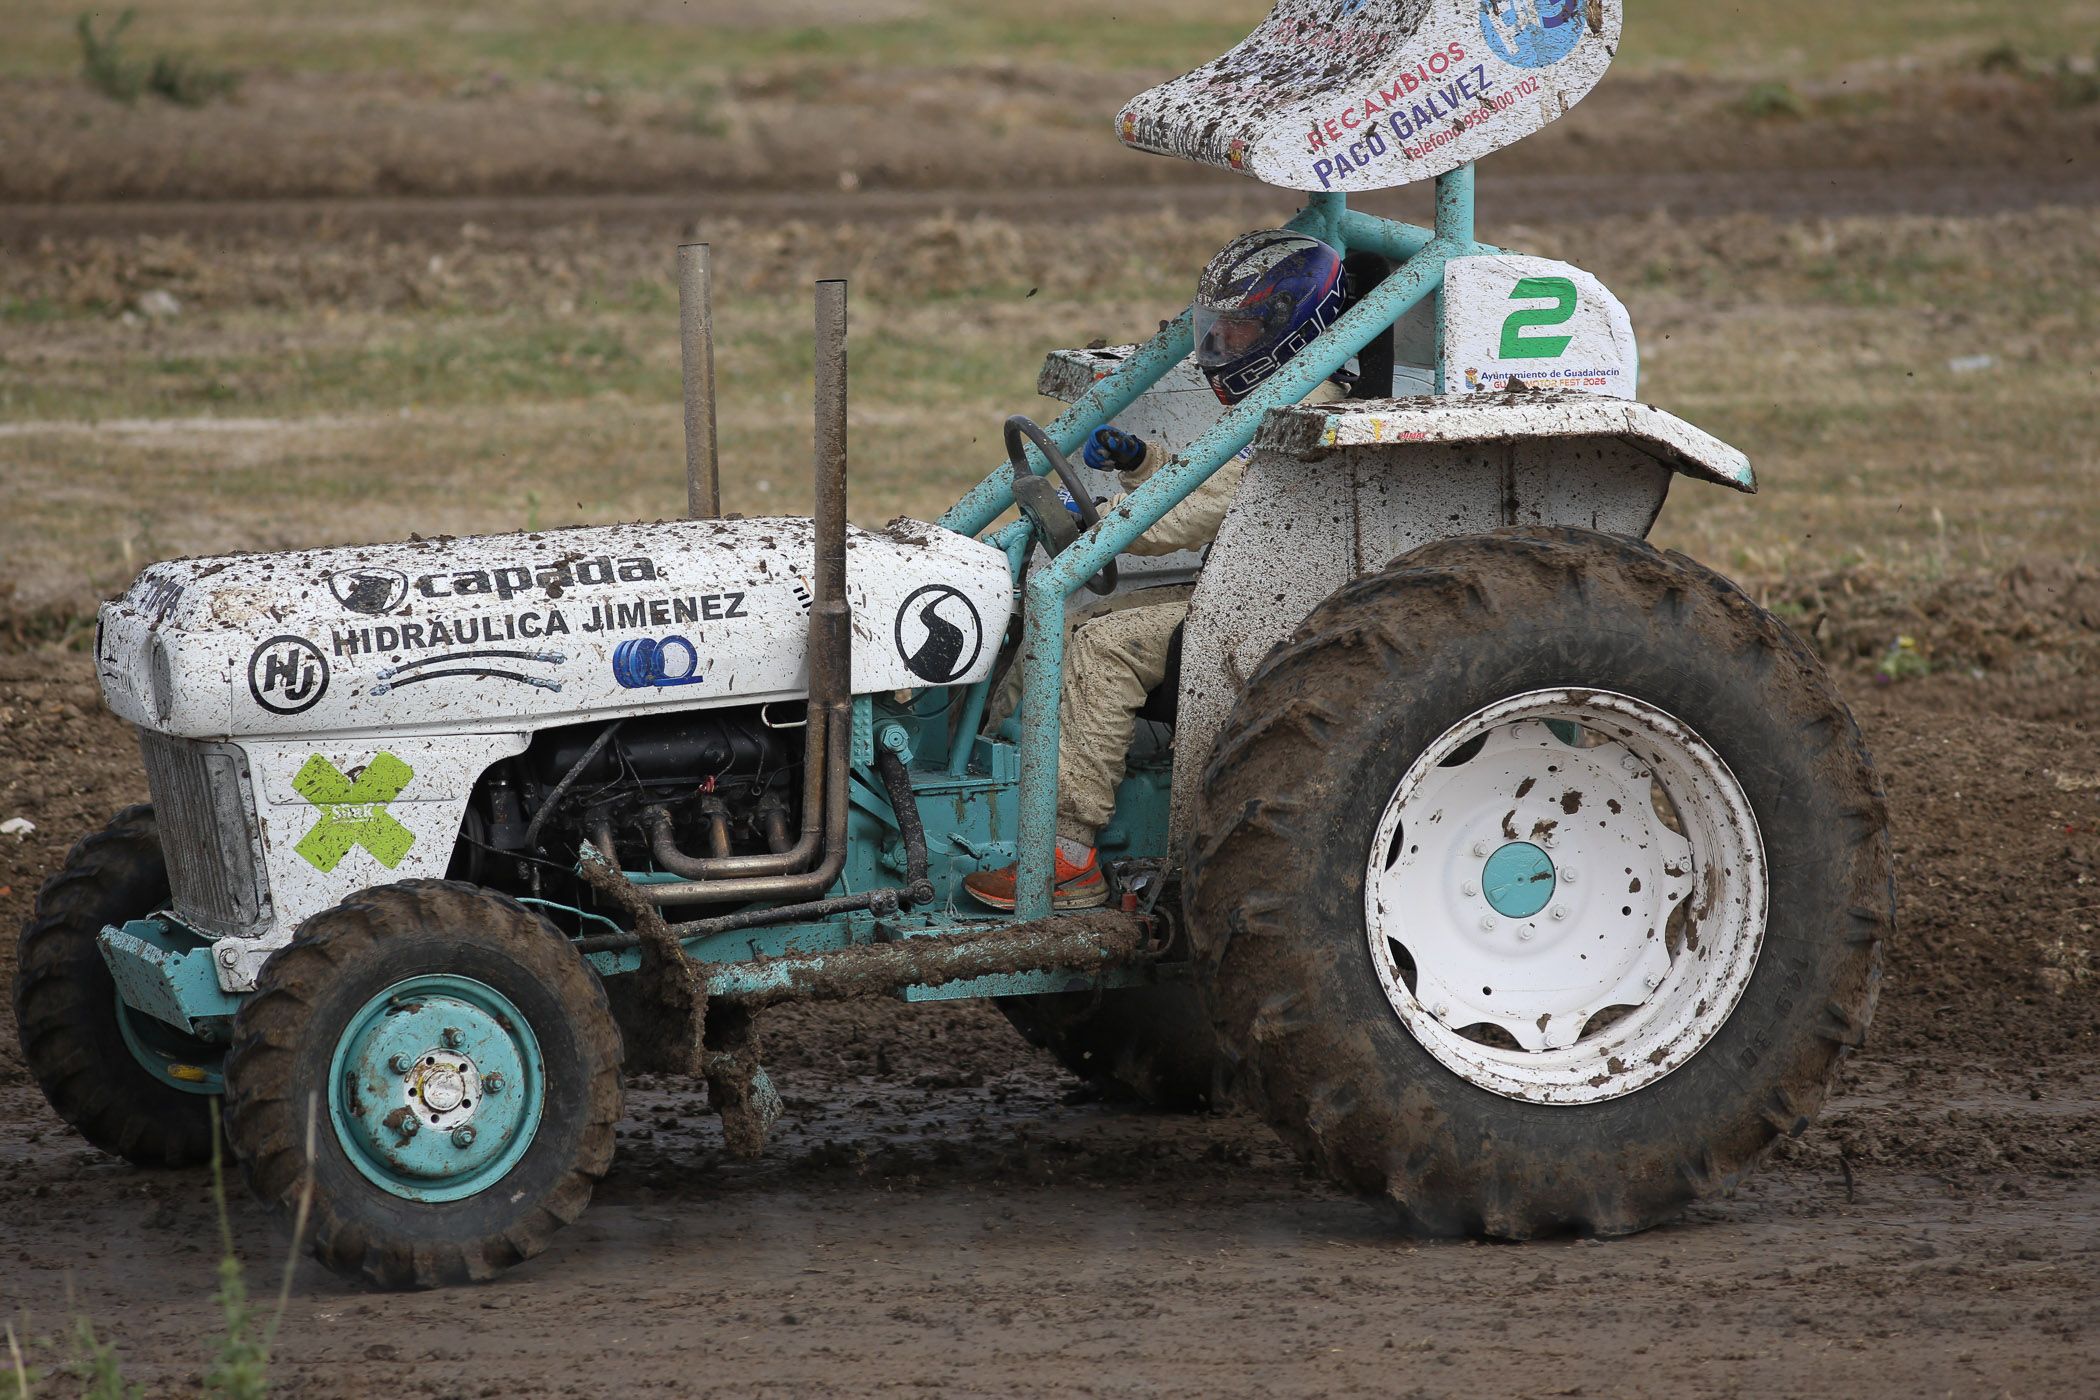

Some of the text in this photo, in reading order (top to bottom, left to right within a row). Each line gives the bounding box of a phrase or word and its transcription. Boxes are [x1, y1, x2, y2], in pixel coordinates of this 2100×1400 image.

[1306, 42, 1465, 152] RECAMBIOS
[1465, 107, 1490, 130] 956
[1489, 90, 1515, 112] 900
[1514, 75, 1540, 100] 102
[1312, 132, 1386, 189] PACO
[1389, 64, 1492, 140] GALVEZ
[1499, 277, 1577, 359] 2
[1550, 370, 1560, 378] de
[1584, 377, 1606, 386] 2026
[418, 555, 657, 600] capada
